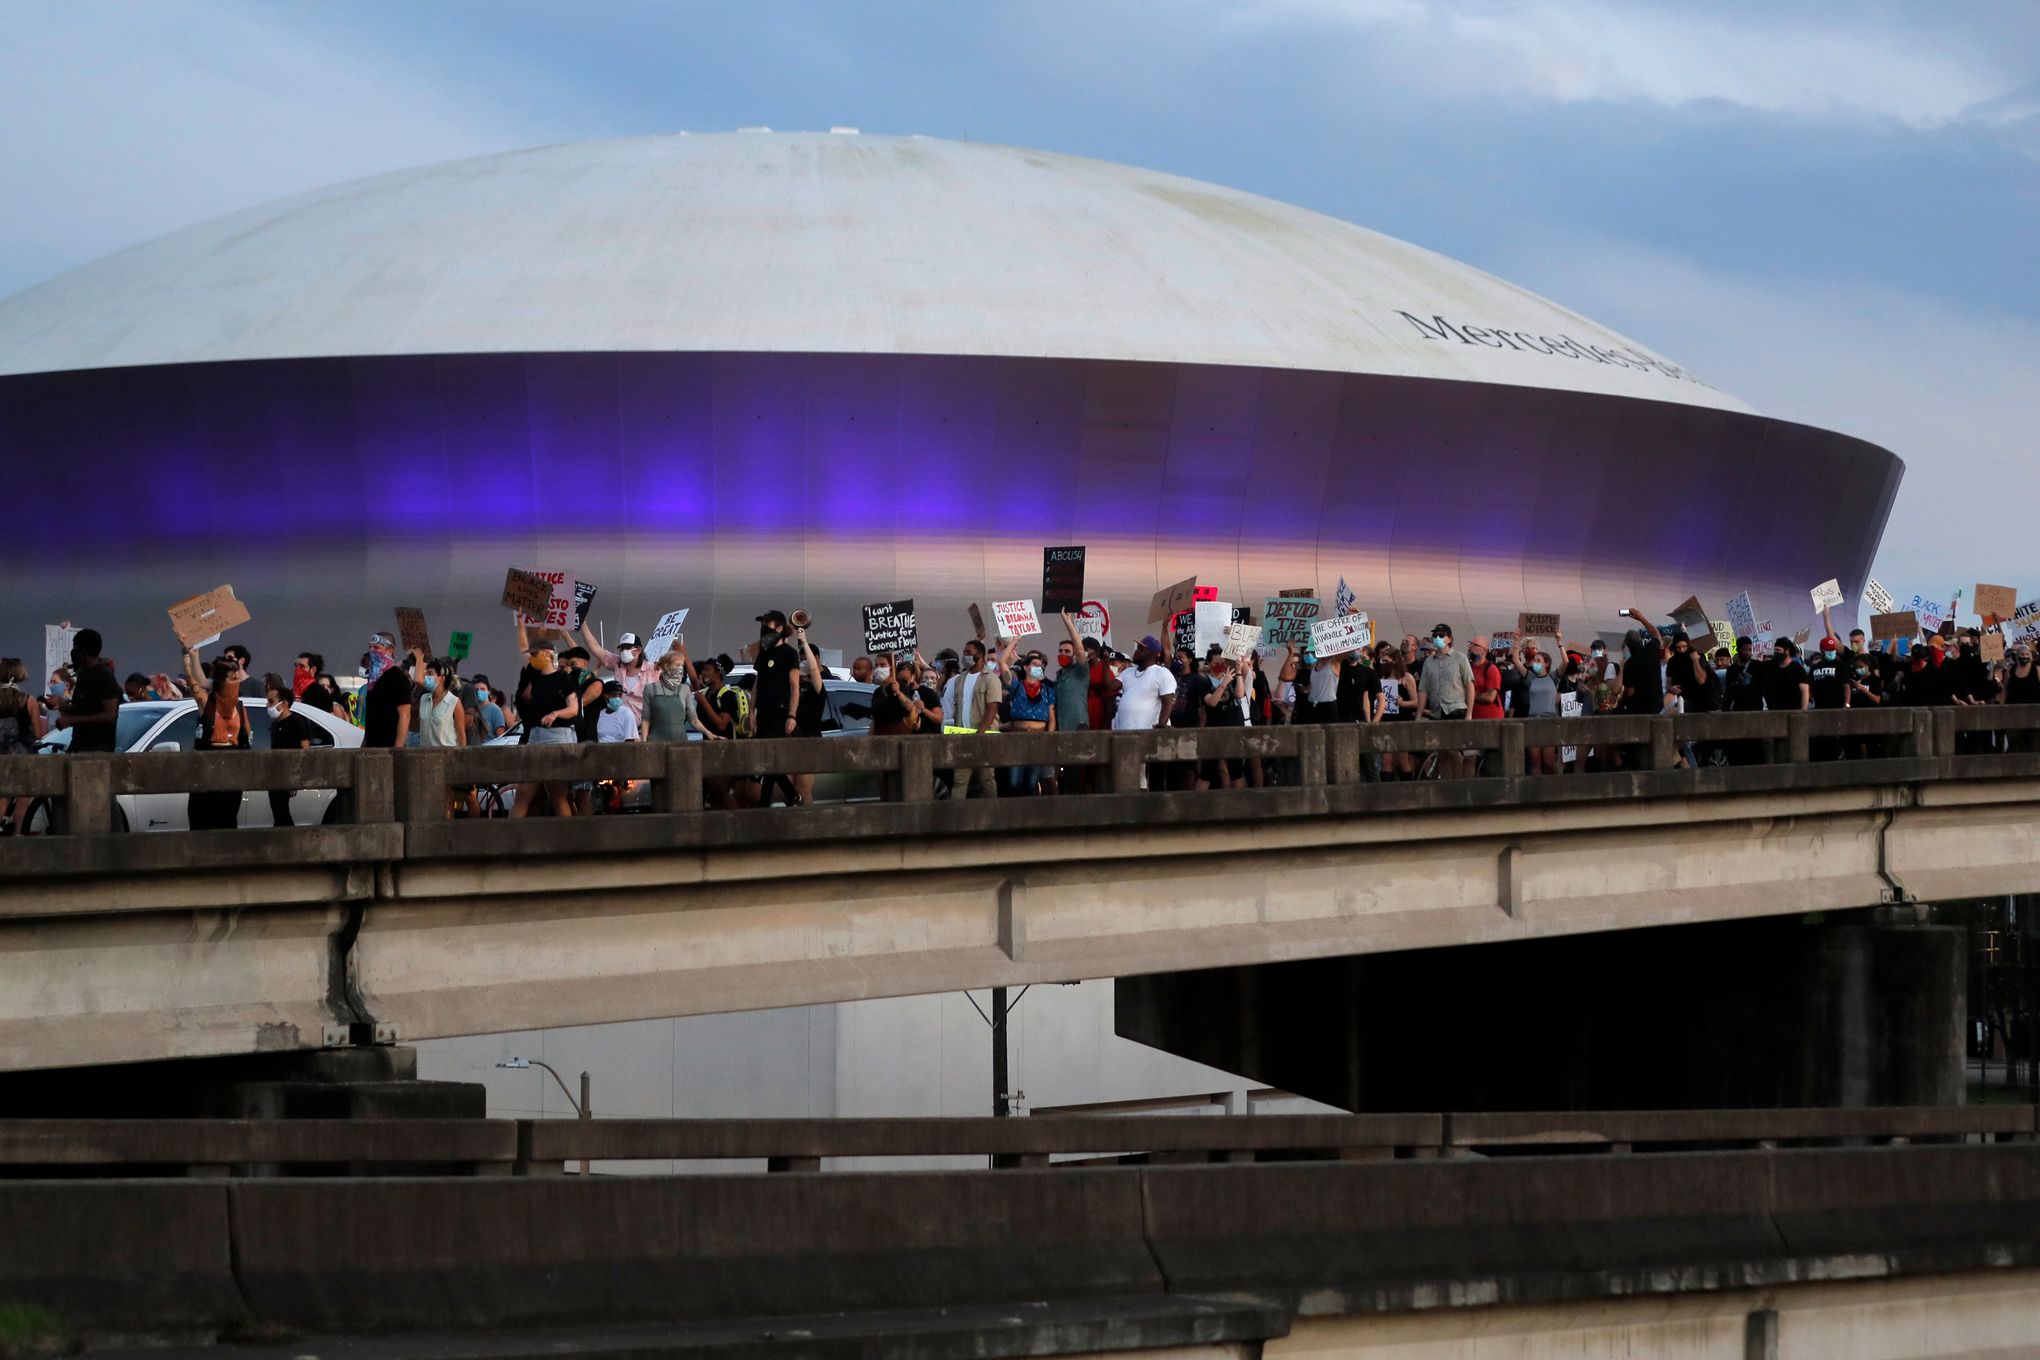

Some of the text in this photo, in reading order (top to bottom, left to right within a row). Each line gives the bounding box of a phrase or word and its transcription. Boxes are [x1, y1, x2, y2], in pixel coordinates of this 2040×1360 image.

[1051, 550, 1083, 561] ABOLISH
[511, 571, 547, 594] BLACK
[506, 590, 547, 618] MATTER
[996, 601, 1026, 613] JUSTICE
[1266, 602, 1319, 618] DEFUND
[1912, 595, 1941, 615] BLACK
[664, 612, 680, 625] BE
[869, 612, 916, 630] BREATHE
[1180, 614, 1194, 624] WE
[1277, 618, 1307, 630] THE
[1312, 613, 1362, 634] THE OFFICE OF
[651, 622, 682, 640] GREAT
[899, 627, 913, 636] for
[1008, 622, 1037, 635] TAYLOR
[2026, 624, 2036, 633] IS
[868, 635, 917, 651] George Floyd
[1269, 629, 1310, 644] POLICE
[1314, 630, 1343, 645] JUVENILE
